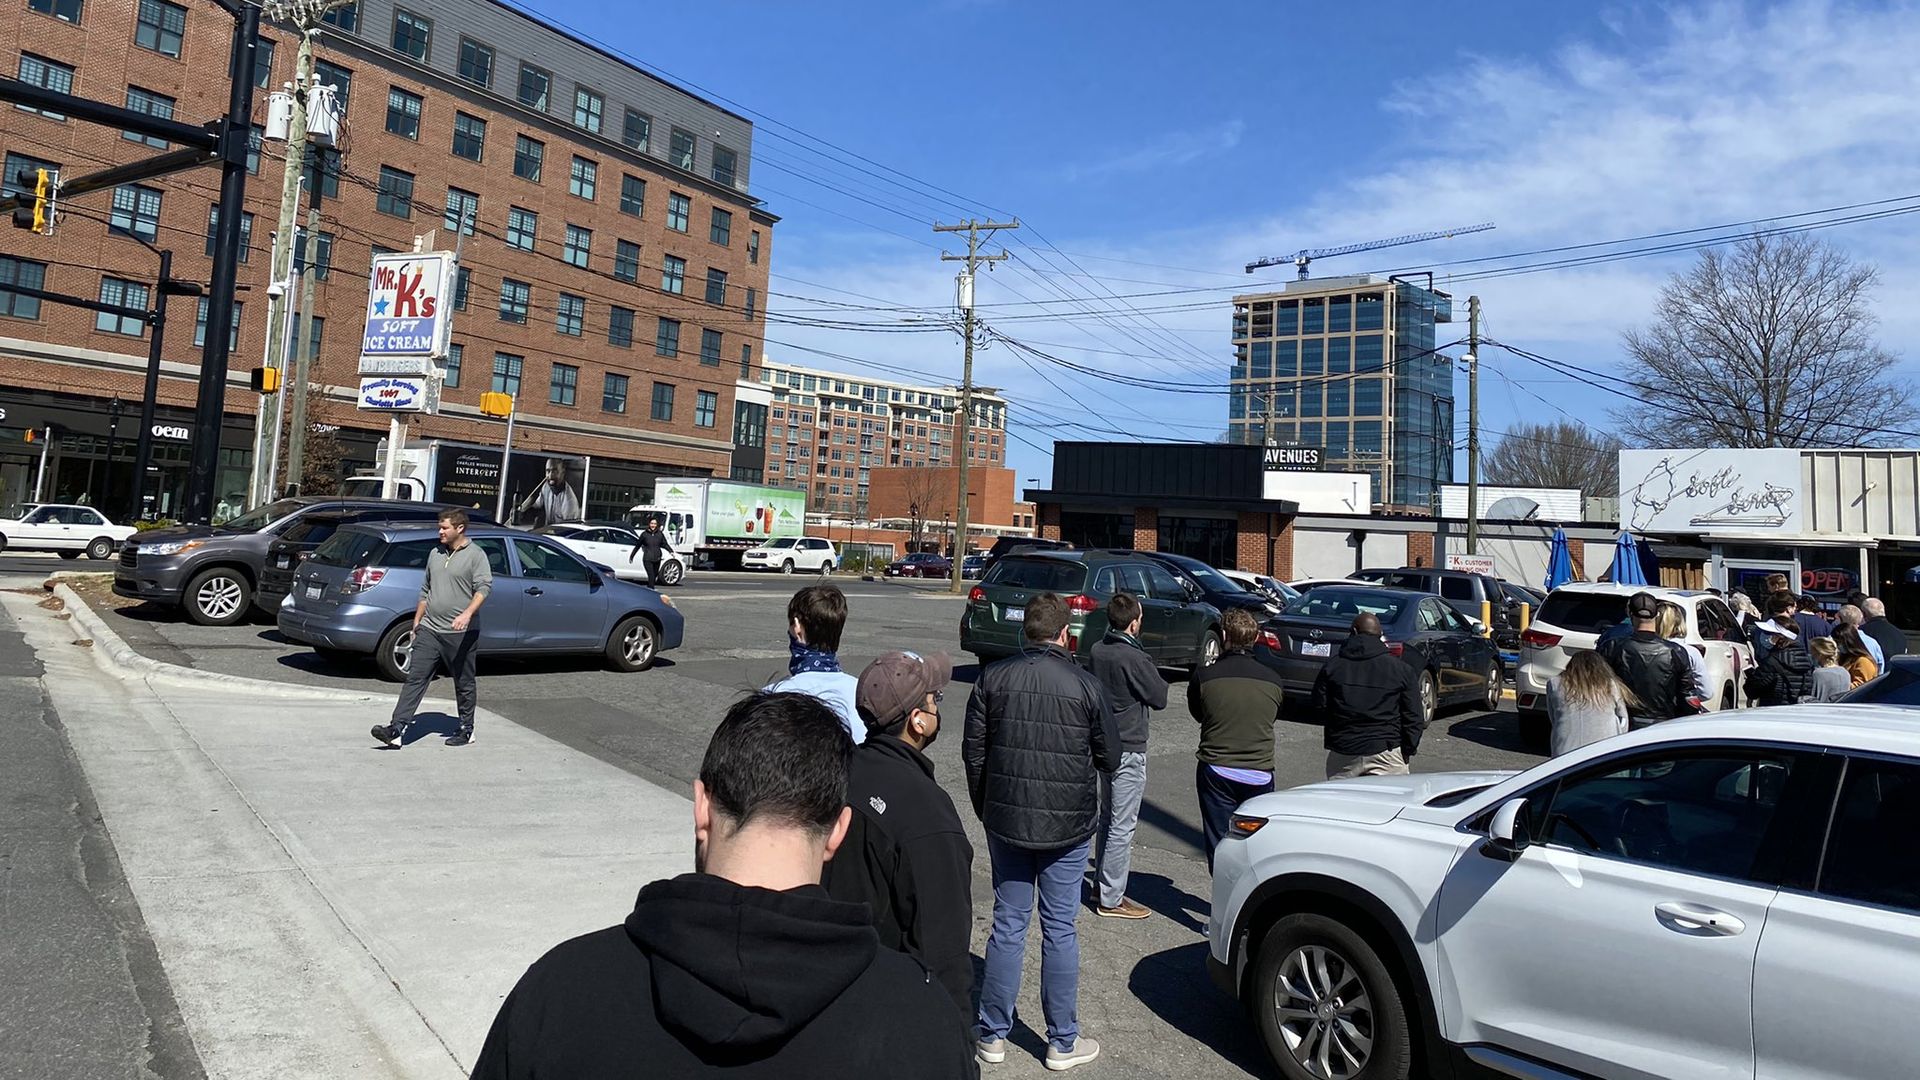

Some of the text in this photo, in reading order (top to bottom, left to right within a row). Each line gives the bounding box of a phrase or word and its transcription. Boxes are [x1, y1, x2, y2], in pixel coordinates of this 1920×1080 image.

[375, 266, 436, 318] MR. K's
[380, 320, 420, 333] SOFT
[365, 335, 432, 350] ICE CREAM
[379, 389, 399, 398] 1967
[151, 425, 189, 440] oem
[1264, 448, 1319, 464] AVENUES
[455, 466, 498, 477] INTERCEPT
[1464, 559, 1493, 567] CUSTOMER
[1801, 570, 1850, 591] OPEN
